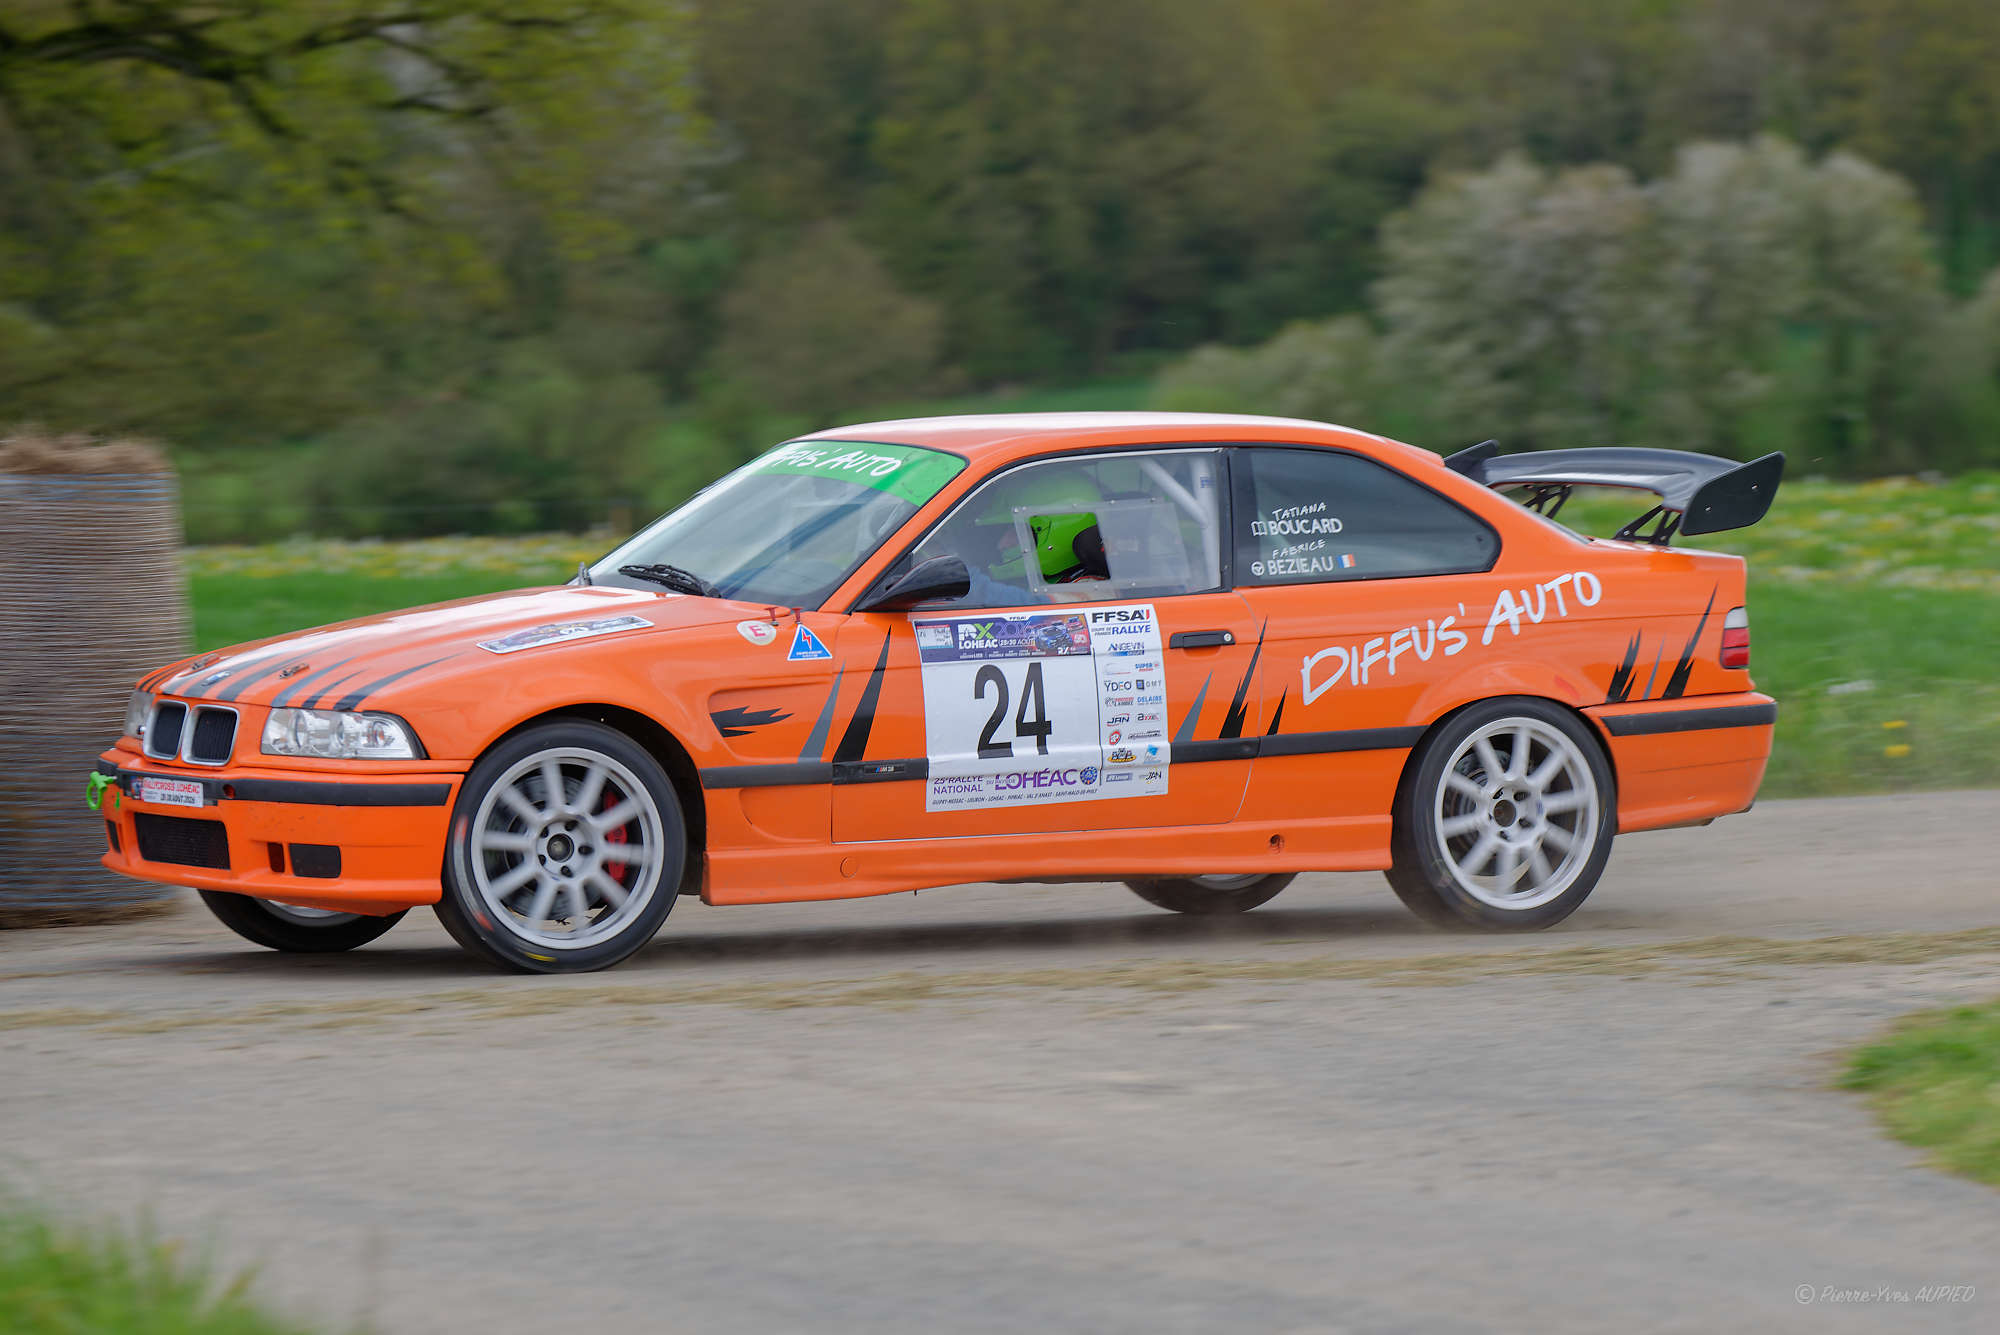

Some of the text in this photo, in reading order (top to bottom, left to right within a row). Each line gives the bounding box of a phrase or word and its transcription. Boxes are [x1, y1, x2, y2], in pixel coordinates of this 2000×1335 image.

[815, 450, 902, 476] AUTO
[1272, 502, 1327, 521] TATIANA
[1267, 518, 1343, 535] BOUCARD
[1272, 539, 1326, 559] FABRICE
[1267, 556, 1334, 575] BEZIEAU
[748, 624, 766, 637] E
[958, 622, 994, 641] RX
[1112, 624, 1151, 635] RALLYE
[1301, 571, 1603, 706] DIFFUS' AUTO
[959, 639, 999, 650] LOHEAC
[1108, 642, 1145, 652] ANGEVIN
[1104, 681, 1132, 692] YDEO
[974, 661, 1052, 760] 24
[994, 768, 1078, 791] LOHÉAC
[933, 784, 984, 795] NATIONAL
